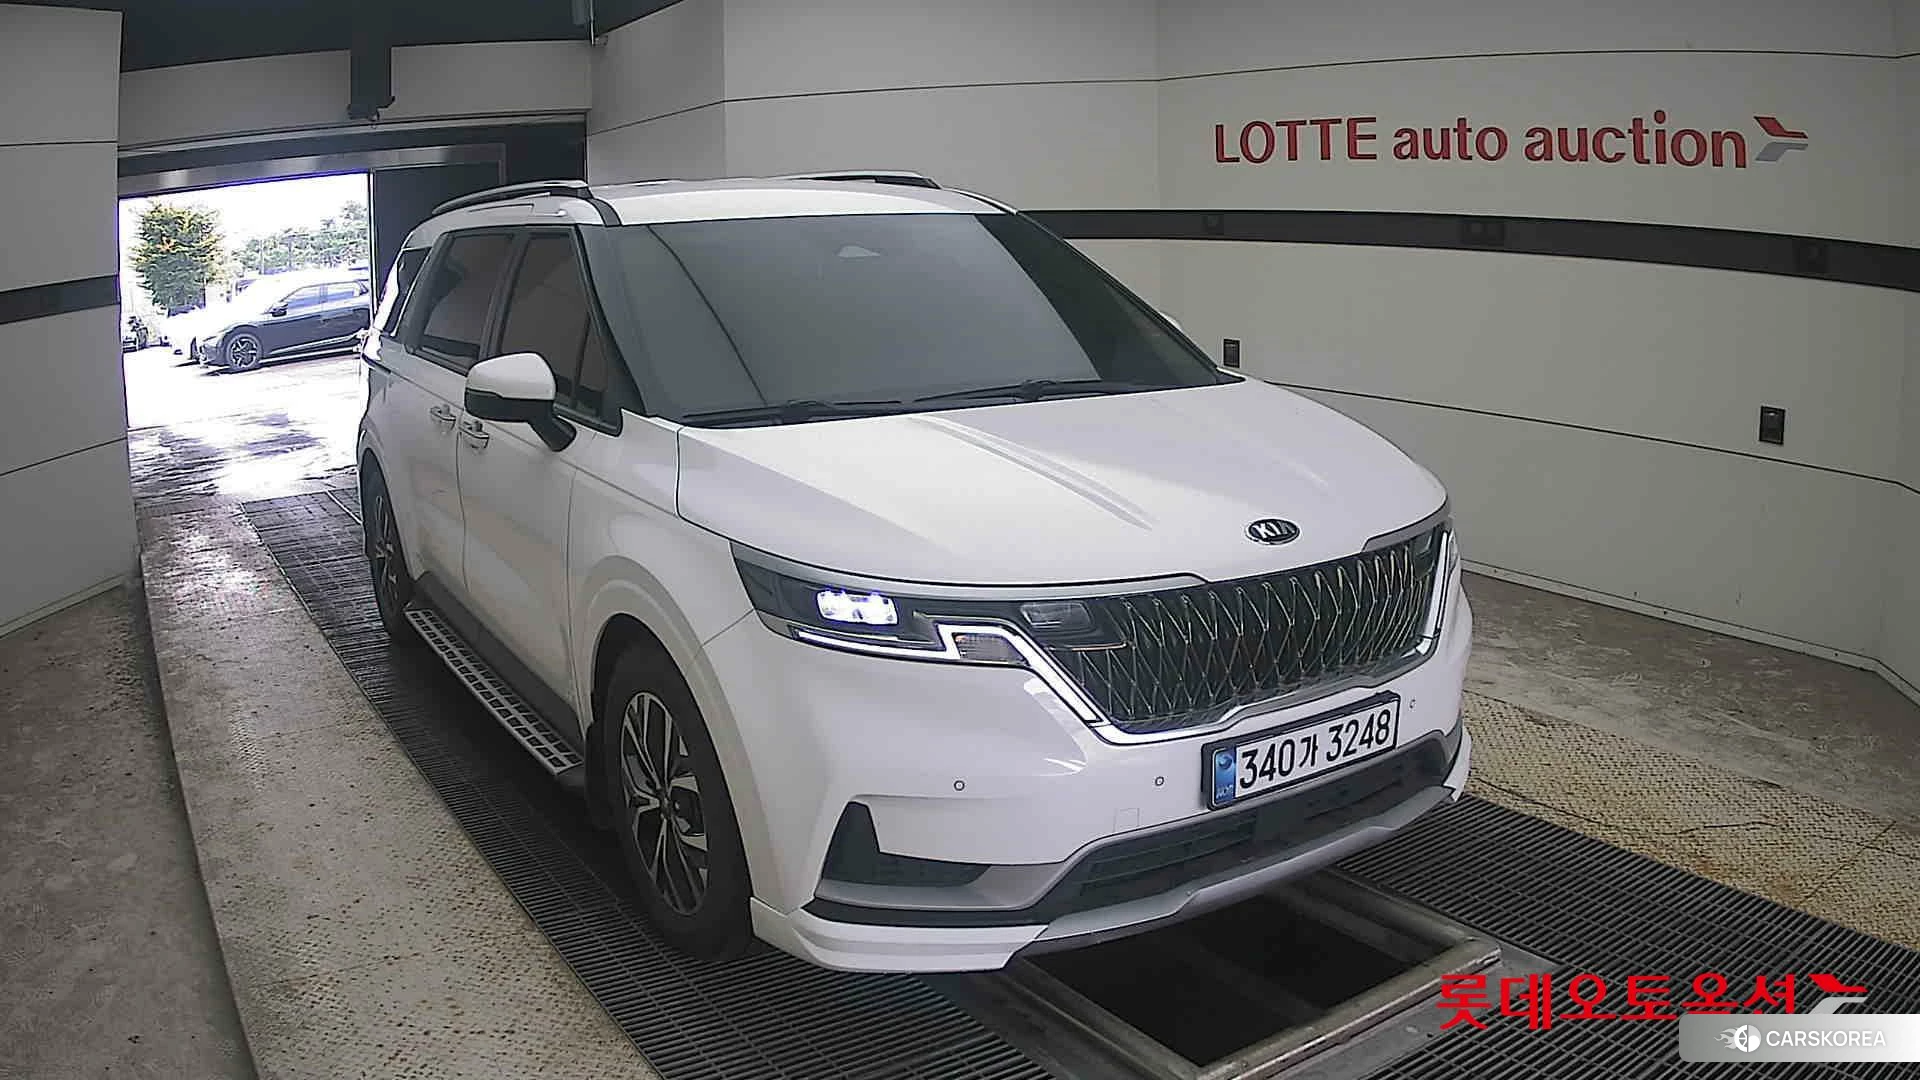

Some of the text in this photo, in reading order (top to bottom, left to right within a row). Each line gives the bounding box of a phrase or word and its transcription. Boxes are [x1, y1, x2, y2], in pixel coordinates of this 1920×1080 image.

[1214, 110, 1747, 169] LOTTE auto auction
[1252, 521, 1295, 538] KIA
[1239, 709, 1391, 789] 340가 3248
